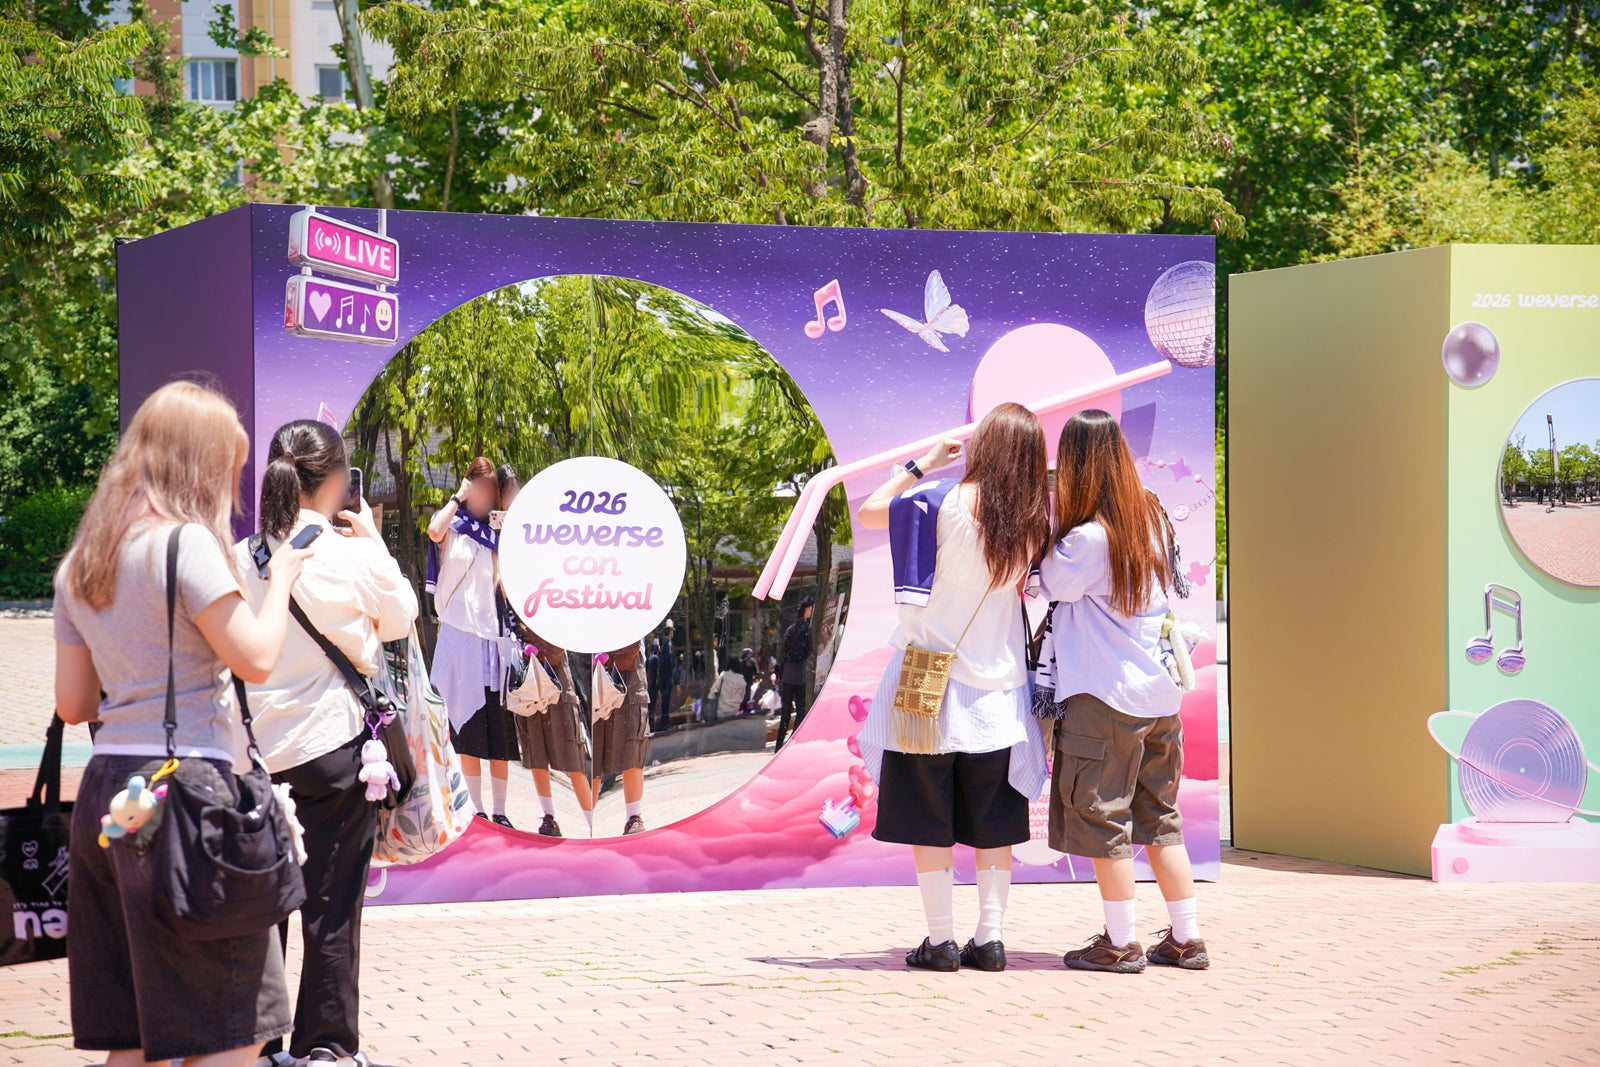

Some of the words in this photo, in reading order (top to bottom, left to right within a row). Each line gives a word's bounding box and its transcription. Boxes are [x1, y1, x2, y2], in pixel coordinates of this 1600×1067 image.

[345, 235, 391, 271] LIVE
[1472, 293, 1511, 308] 2026
[1517, 293, 1599, 308] weverse
[559, 490, 627, 515] 2026
[522, 523, 664, 547] weverse
[562, 555, 622, 576] con
[523, 578, 653, 618] festival
